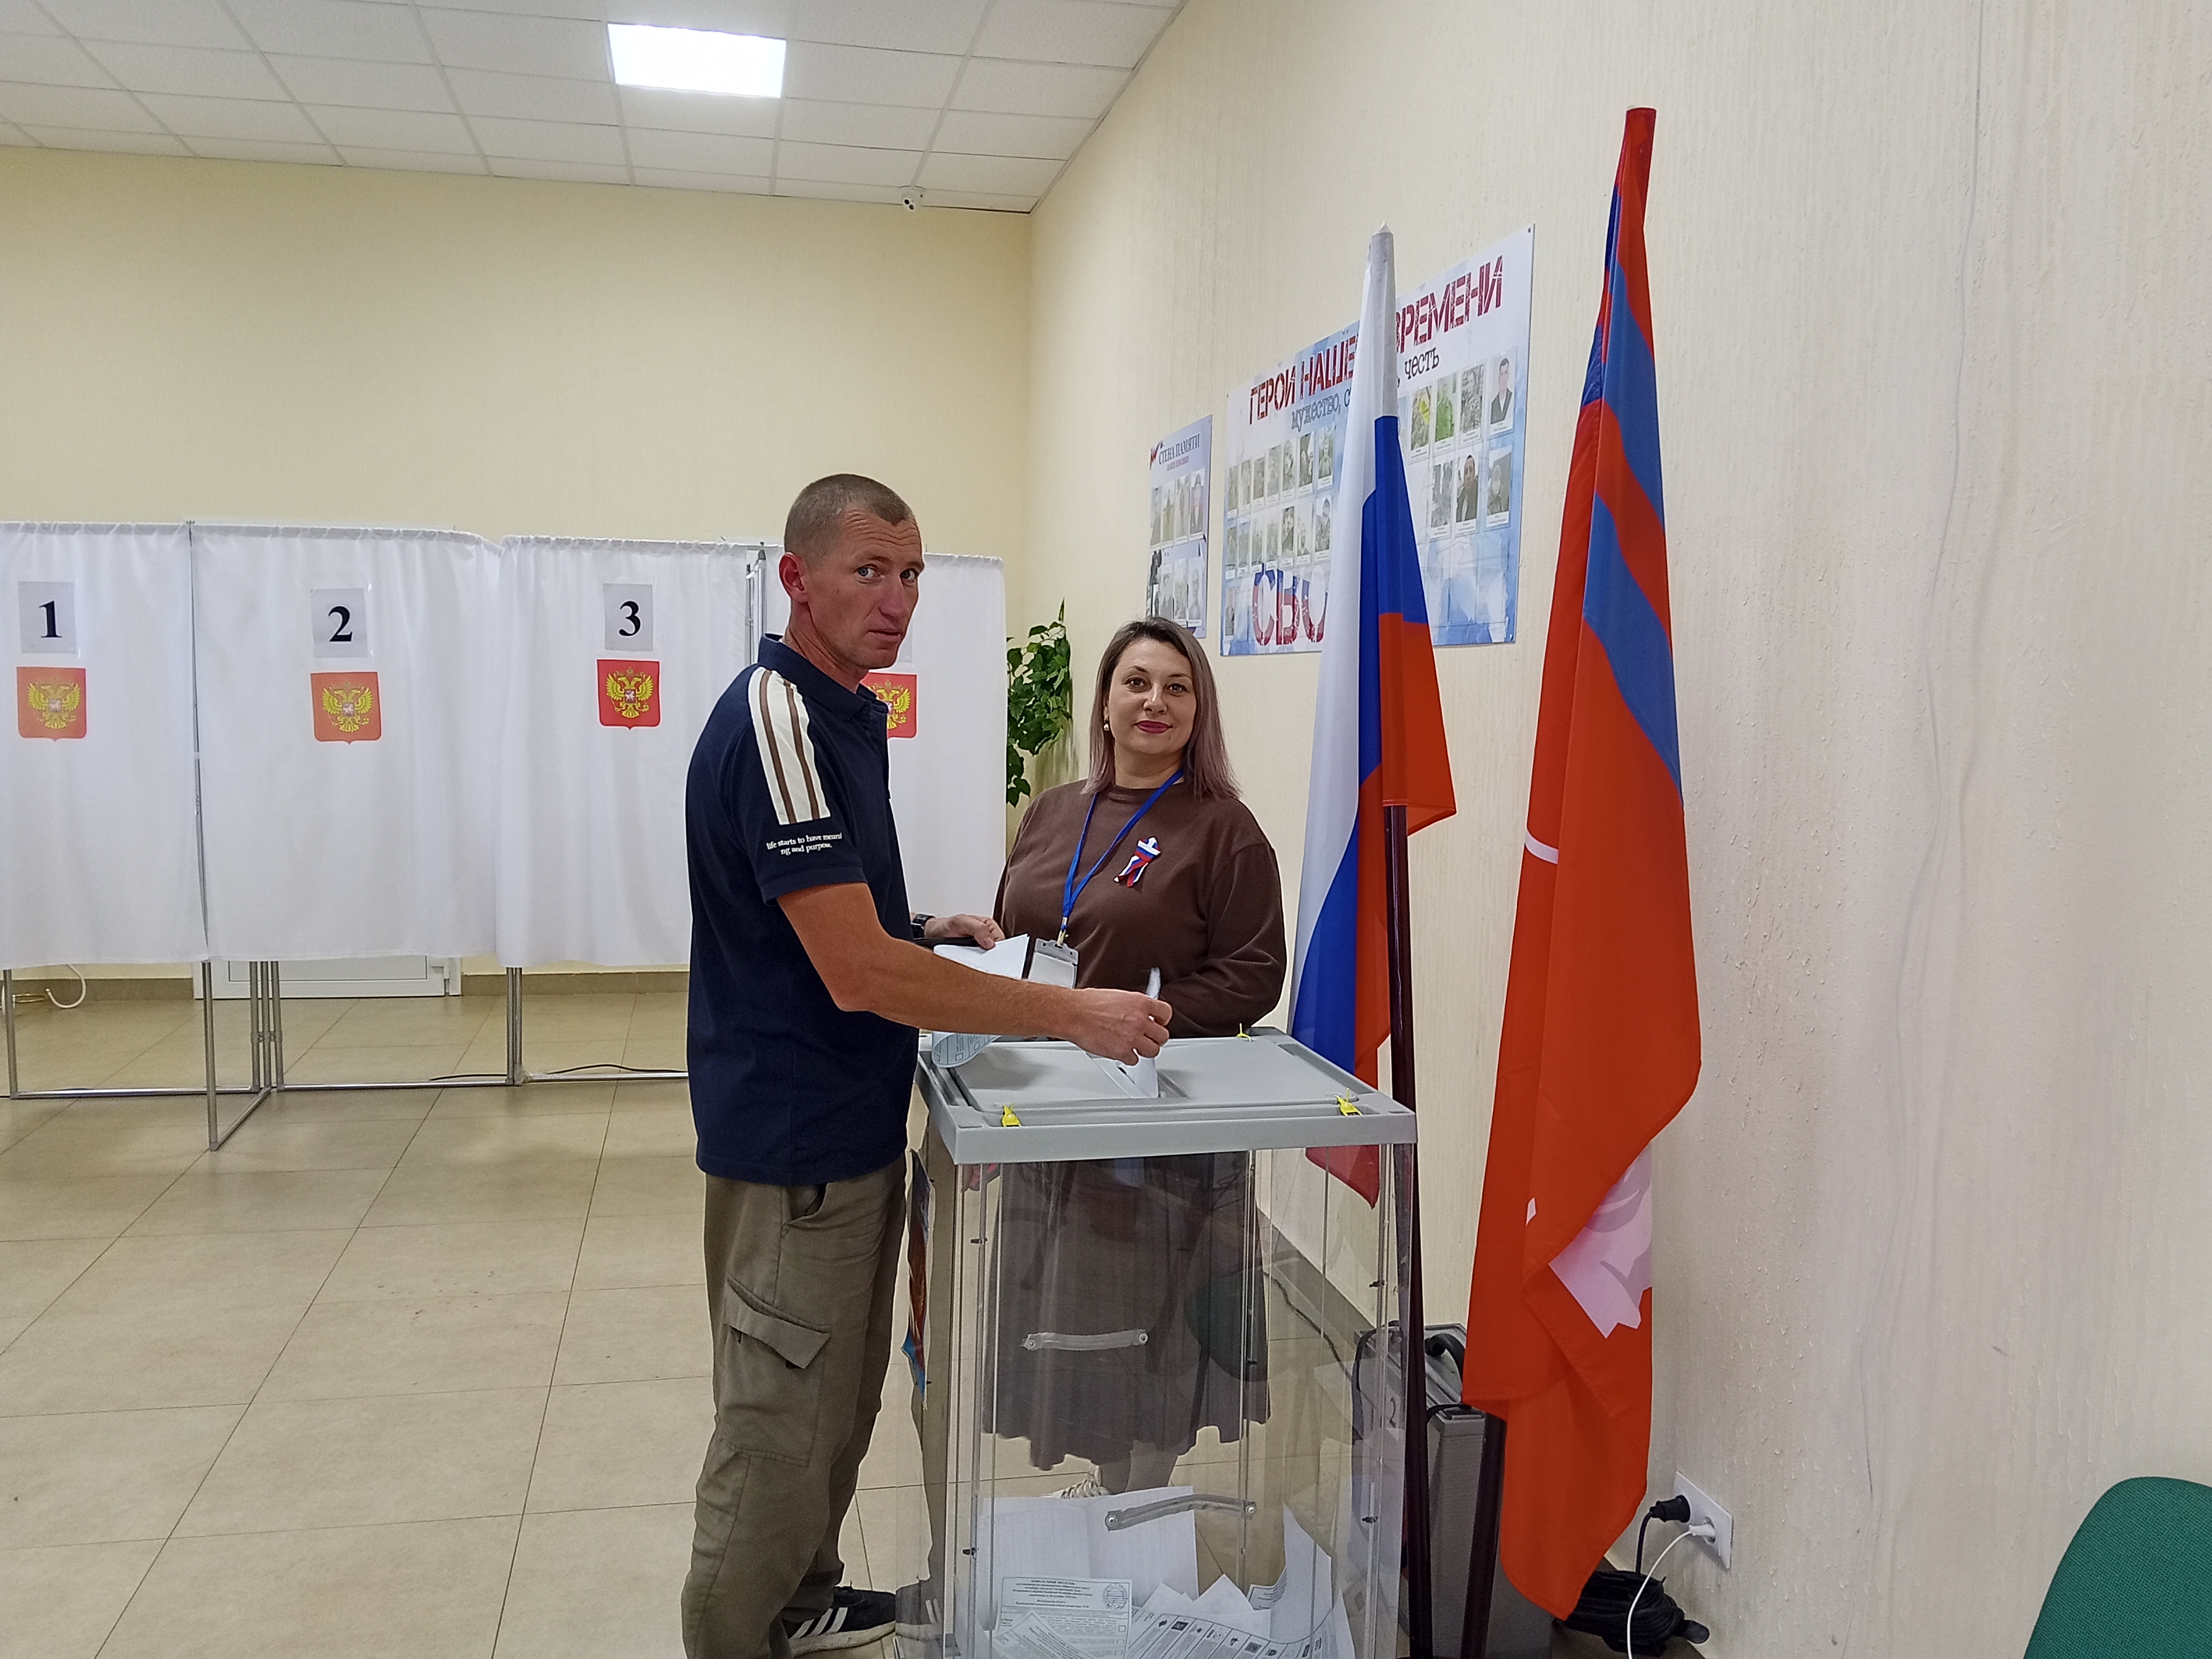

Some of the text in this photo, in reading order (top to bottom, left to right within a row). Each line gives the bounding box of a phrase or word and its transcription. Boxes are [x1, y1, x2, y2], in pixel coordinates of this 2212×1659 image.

[1249, 365, 1296, 425] ГЕРОИ
[1300, 333, 1359, 400] НАШЕ
[1405, 347, 1440, 380] честь
[1159, 446, 1175, 464] СТЕНА
[39, 601, 62, 638] 1
[328, 606, 353, 643] 2
[618, 601, 641, 636] 3
[766, 841, 777, 850] life
[778, 839, 797, 847] starts
[806, 834, 822, 842] have
[780, 847, 791, 855] ng
